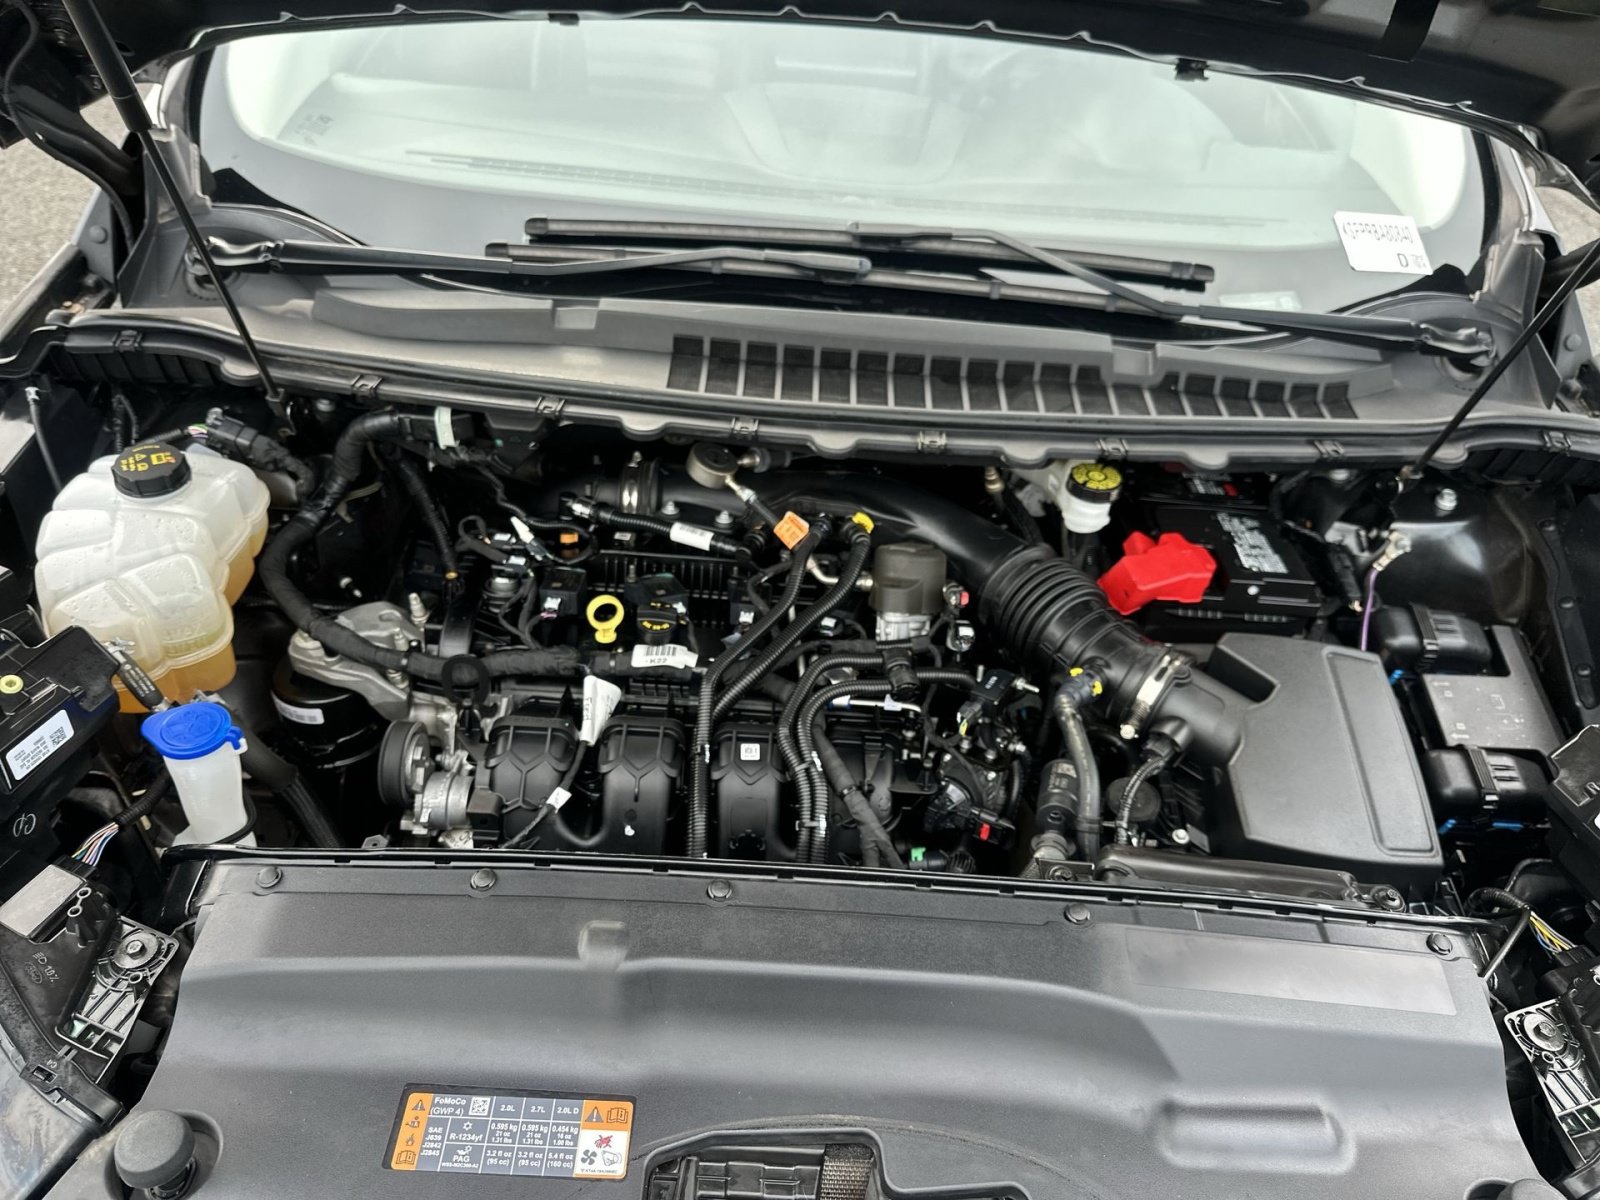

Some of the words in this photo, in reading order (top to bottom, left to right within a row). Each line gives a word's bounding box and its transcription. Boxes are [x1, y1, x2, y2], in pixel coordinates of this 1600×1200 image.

[1397, 253, 1409, 268] D
[434, 1097, 467, 1105] FoMoCo
[430, 1107, 454, 1116] (GWP
[455, 1108, 464, 1117] 4)
[509, 1124, 518, 1132] kg
[540, 1125, 549, 1133] kg
[570, 1126, 579, 1135] kg
[449, 1133, 483, 1142] R-1234yf
